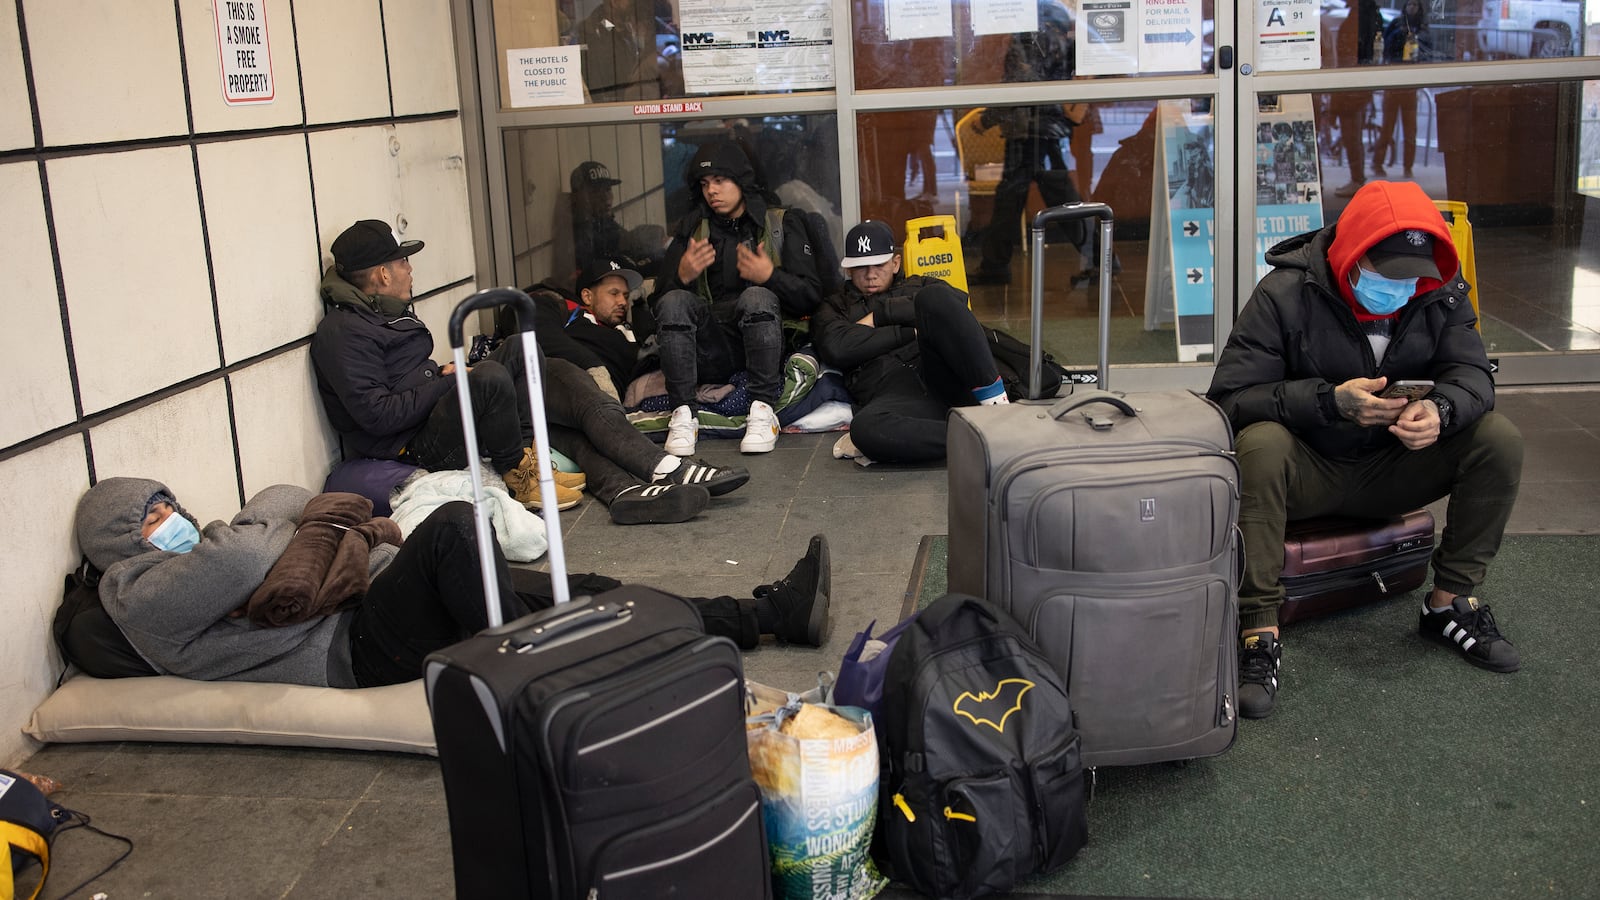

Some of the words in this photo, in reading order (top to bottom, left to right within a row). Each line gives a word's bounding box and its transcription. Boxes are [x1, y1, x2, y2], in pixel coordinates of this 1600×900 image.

[226, 2, 245, 20] THIS
[247, 3, 255, 21] IS
[1267, 7, 1285, 27] A
[1293, 11, 1303, 19] 91
[227, 26, 232, 44] A
[234, 26, 261, 44] SMOKE
[683, 32, 714, 44] NYC
[758, 30, 789, 42] NYC
[236, 50, 256, 68] FREE
[535, 56, 560, 64] HOTEL
[524, 68, 552, 76] CLOSED
[554, 67, 565, 75] TO
[228, 73, 268, 93] PROPERTY
[540, 78, 567, 87] PUBLIC
[634, 104, 661, 114] CAUTION
[662, 103, 683, 113] STAND
[685, 102, 702, 112] BACK
[1269, 216, 1285, 233] TO
[1287, 215, 1310, 232] THE
[858, 235, 871, 253] NY
[917, 253, 953, 267] CLOSED
